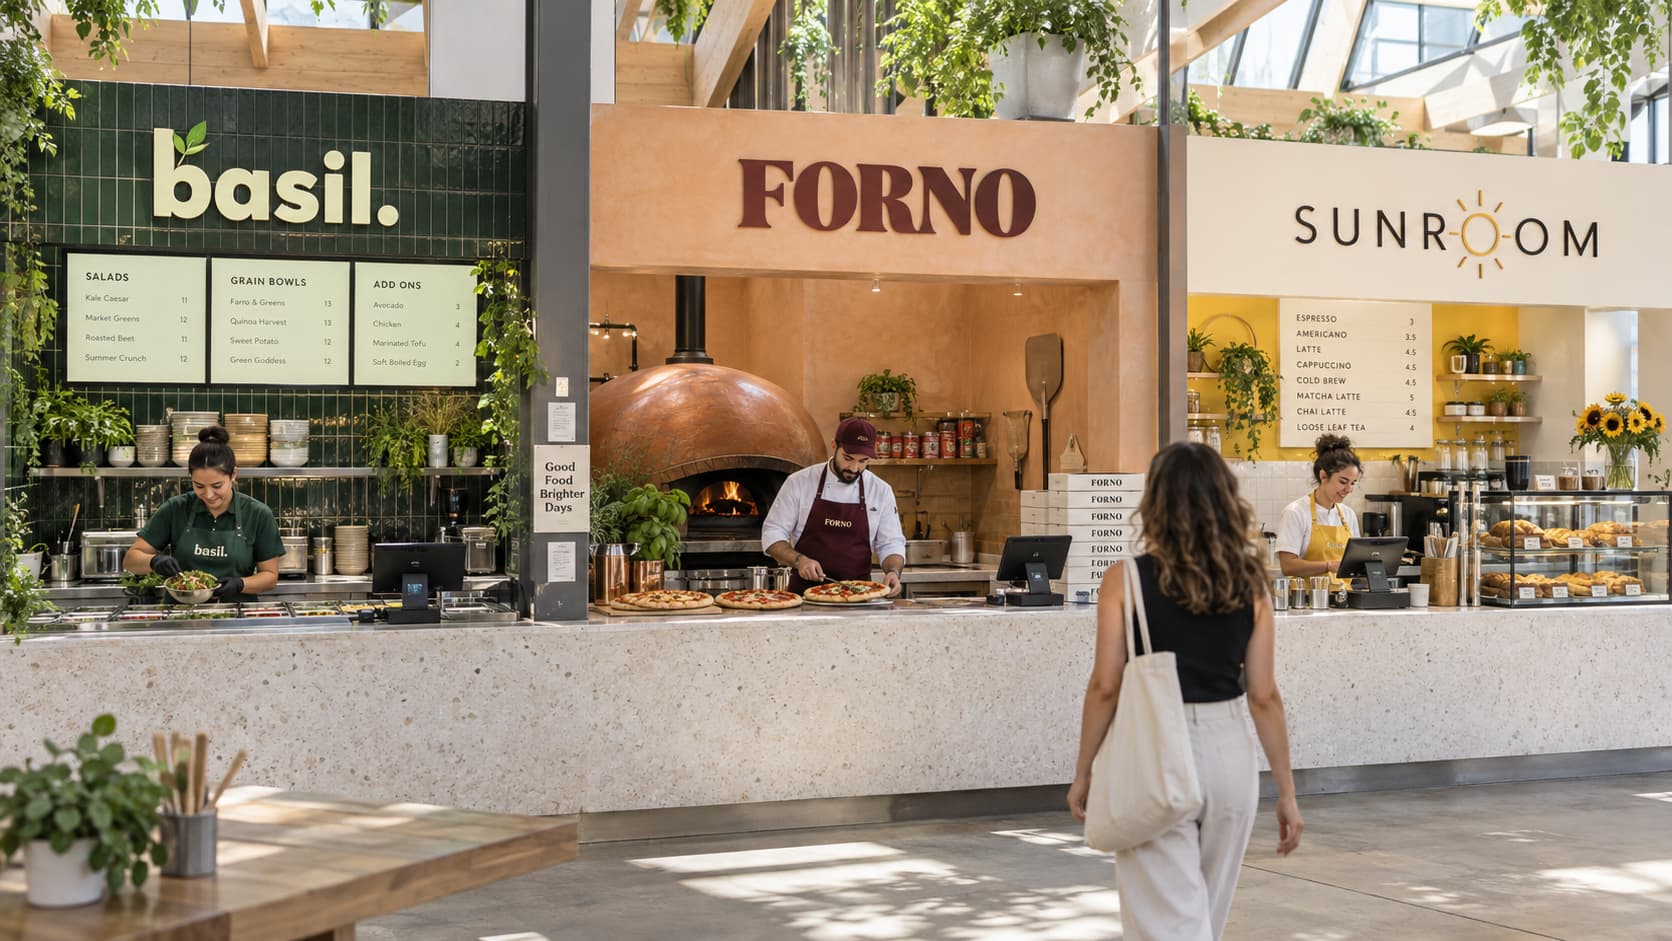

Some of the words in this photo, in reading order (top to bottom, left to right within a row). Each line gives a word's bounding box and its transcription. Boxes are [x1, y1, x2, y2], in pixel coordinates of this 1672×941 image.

[153, 127, 400, 227] basil.
[737, 158, 1036, 238] FORNO
[1295, 205, 1599, 257] SUNROOM
[85, 272, 129, 282] SALADS
[230, 276, 265, 286] GRAIN
[268, 278, 307, 286] BOWLS
[373, 280, 396, 289] ADD
[399, 281, 422, 289] ONS
[103, 295, 129, 303] Caesar
[373, 301, 404, 309] Avocado
[113, 315, 140, 323] Greens
[230, 318, 257, 326] Quinoa
[259, 318, 287, 326] Harvest
[1296, 314, 1337, 323] ESPRESSO
[372, 320, 402, 328] Chicken
[85, 334, 116, 342] Roasted
[1296, 330, 1348, 339] AMERICANO
[230, 337, 253, 345] Sweet
[372, 339, 409, 347] Marinated
[85, 354, 117, 362] Summer
[230, 356, 253, 364] Green
[413, 359, 427, 367] Egg
[1296, 361, 1352, 370] CAPPUCCINO
[1296, 376, 1320, 385] COLD
[1322, 377, 1347, 385] BREW
[1296, 392, 1333, 400] MATCHA
[1335, 393, 1361, 401] LATTE
[1296, 408, 1318, 416] CHAI
[1320, 408, 1347, 416] LATTE
[1404, 409, 1417, 417] 4.5
[1296, 423, 1325, 431] LOOSE
[1327, 423, 1347, 431] LEAF
[1409, 424, 1415, 432] 4
[545, 461, 576, 472] Good
[545, 475, 573, 485] Food
[1091, 479, 1122, 487] FORNO
[540, 489, 585, 501] Brighter
[1091, 495, 1122, 503] FORNO
[545, 503, 572, 515] Days
[1091, 512, 1122, 520] FORNO
[824, 518, 852, 528] FORNO
[1091, 529, 1122, 537] FORNO
[194, 543, 228, 557] basil.
[1091, 545, 1122, 553] FORNO
